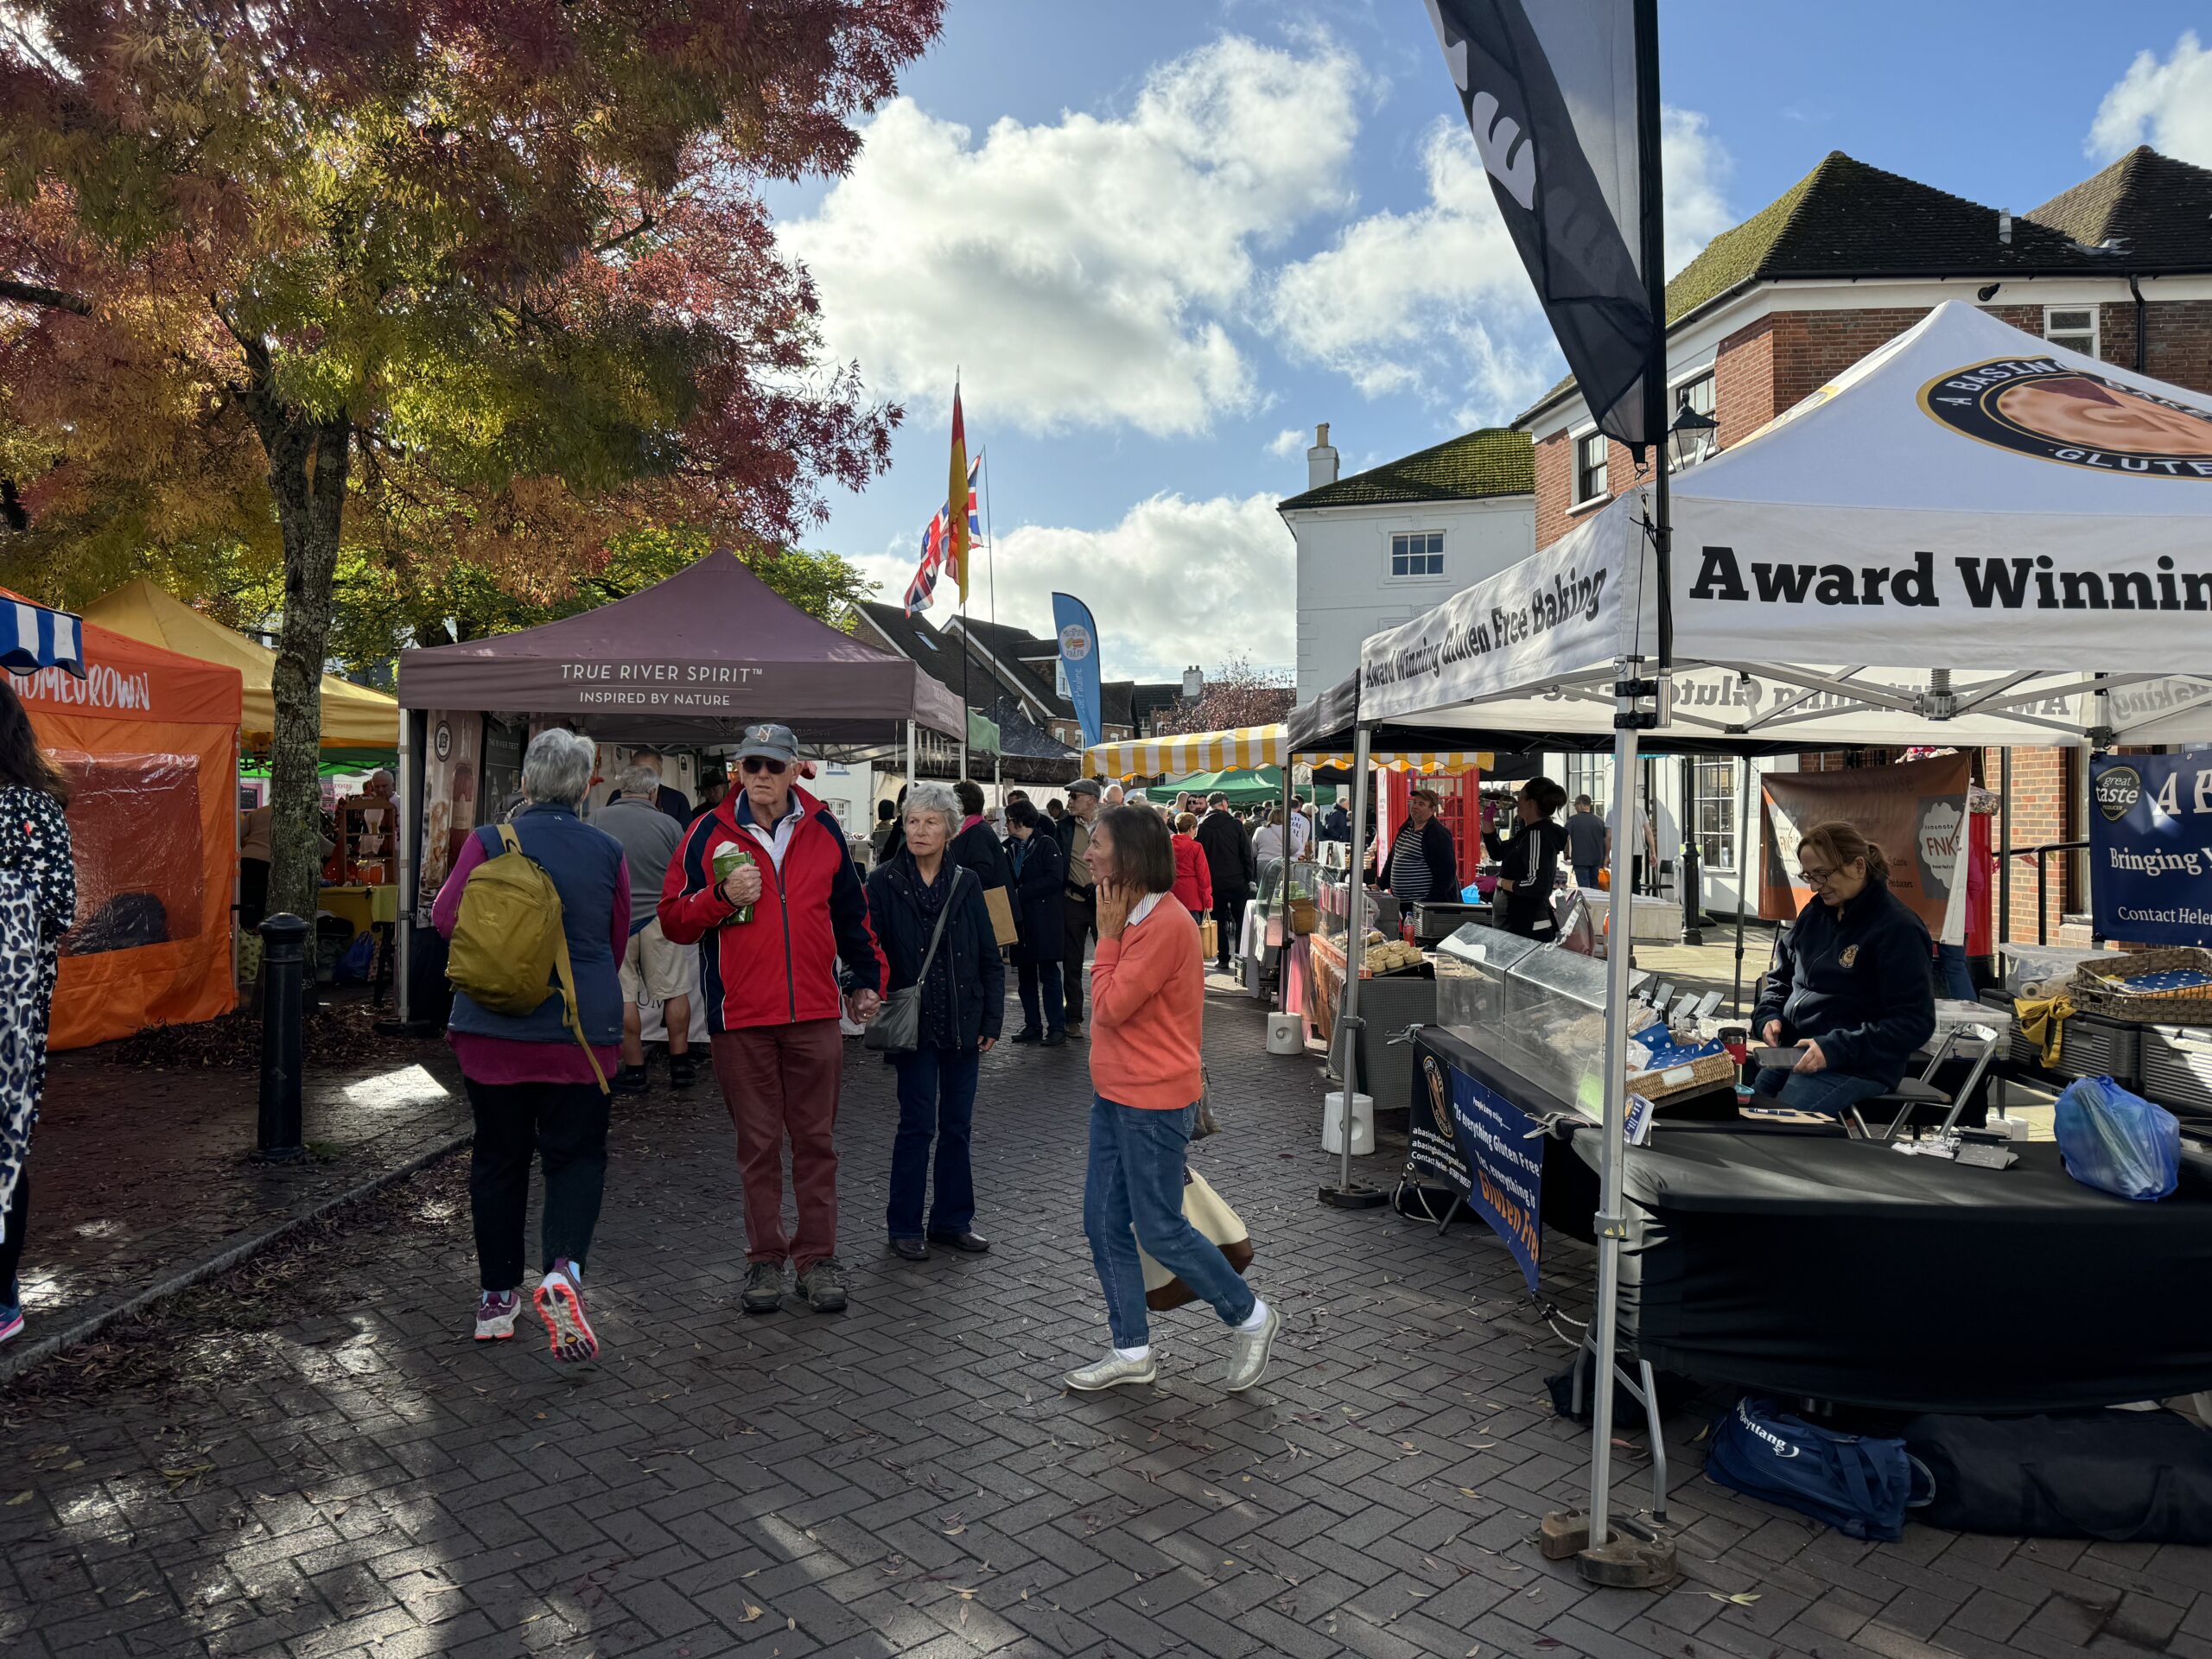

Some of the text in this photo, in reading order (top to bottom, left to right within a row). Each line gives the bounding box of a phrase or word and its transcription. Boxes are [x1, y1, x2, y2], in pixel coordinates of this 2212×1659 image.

[1689, 545, 1940, 607] Award
[1365, 567, 1607, 688] Award Winning Gluten Free Baking
[562, 664, 612, 679] TRUE
[620, 665, 678, 681] RIVER
[580, 692, 730, 706] INSPIRED BY NATURE
[2095, 786, 2139, 804] taste
[2102, 776, 2132, 787] great
[2152, 772, 2182, 815] A
[2109, 847, 2202, 876] Bringing
[2118, 906, 2177, 923] Contact
[1462, 1115, 1493, 1151] everything
[1493, 1135, 1519, 1166] Gluten
[1411, 1151, 1435, 1166] Contact
[1478, 1168, 1522, 1234] Gluten
[1490, 1164, 1529, 1207] everything
[1529, 1185, 1535, 1209] is
